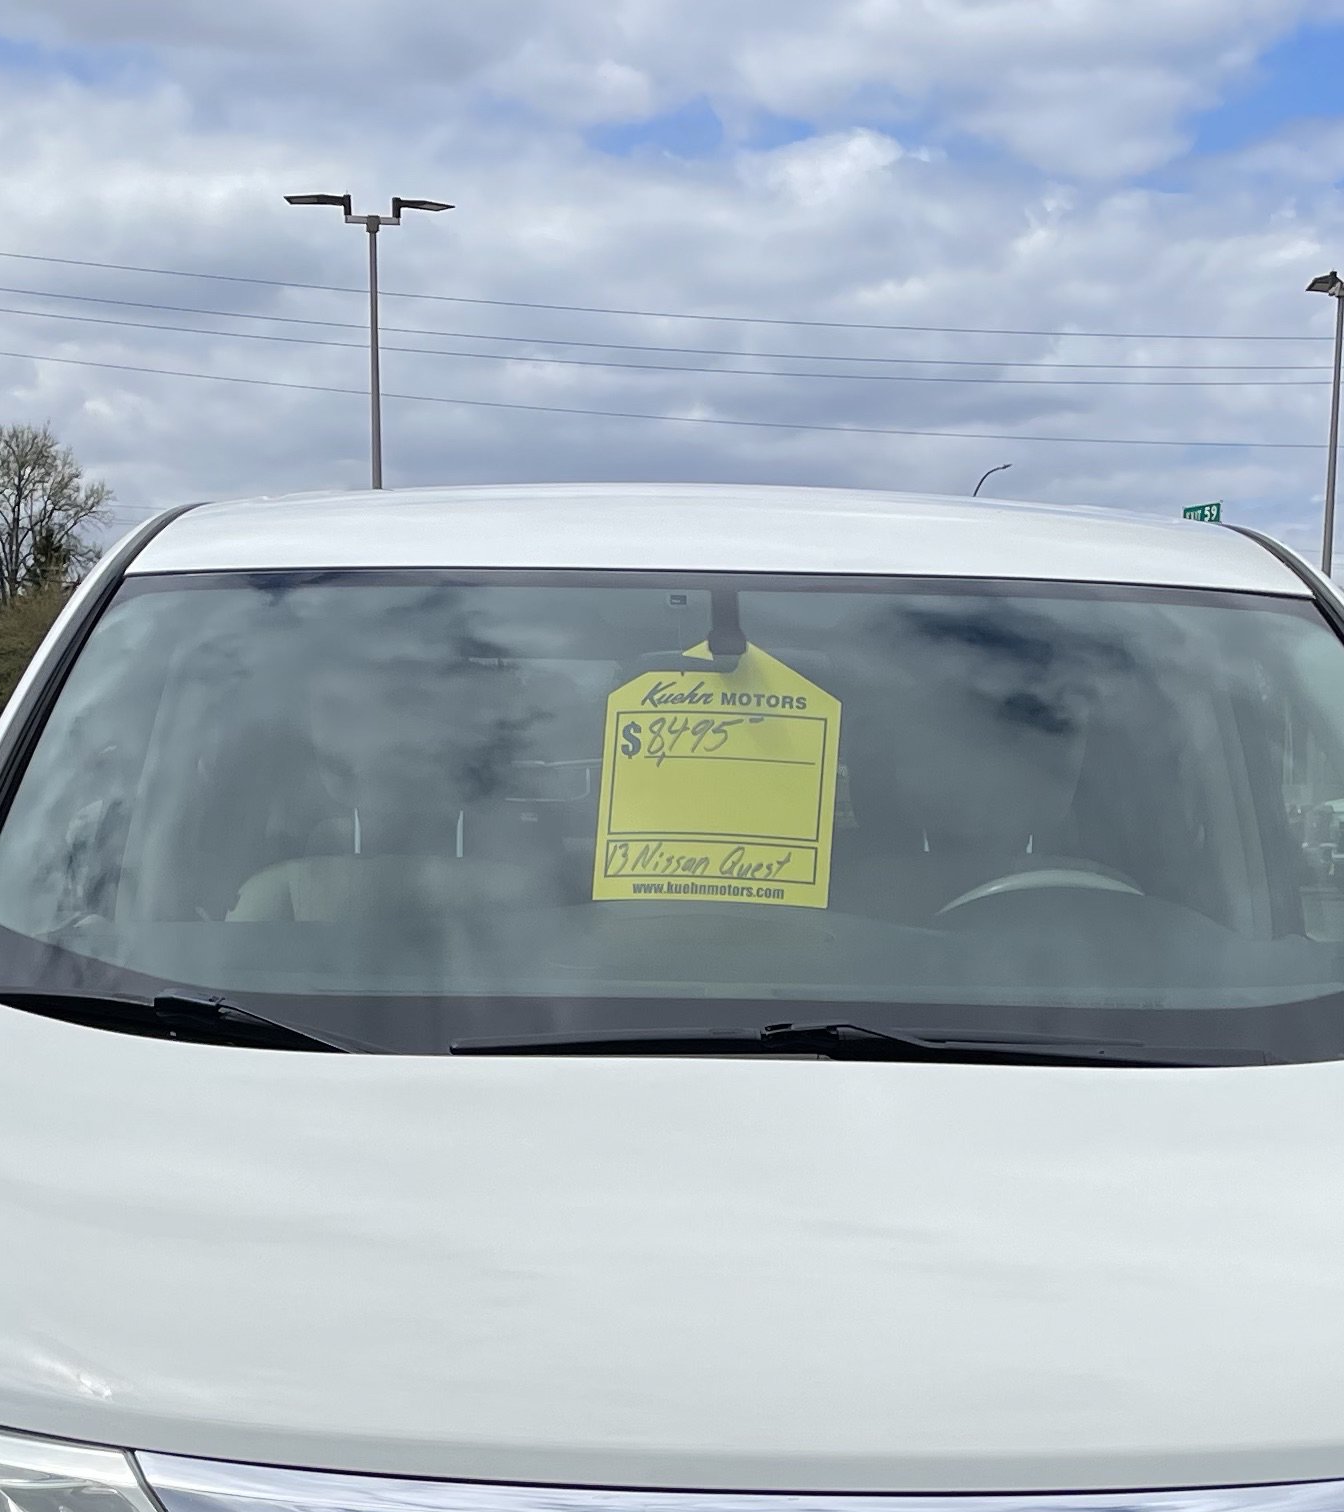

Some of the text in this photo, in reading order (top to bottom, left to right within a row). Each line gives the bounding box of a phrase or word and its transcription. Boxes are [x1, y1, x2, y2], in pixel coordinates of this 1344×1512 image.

[641, 681, 808, 710] Kuehn MOTORS
[631, 842, 710, 874] Nissan
[719, 845, 792, 879] Quest
[632, 881, 785, 900] www.kuehnmotors.com
